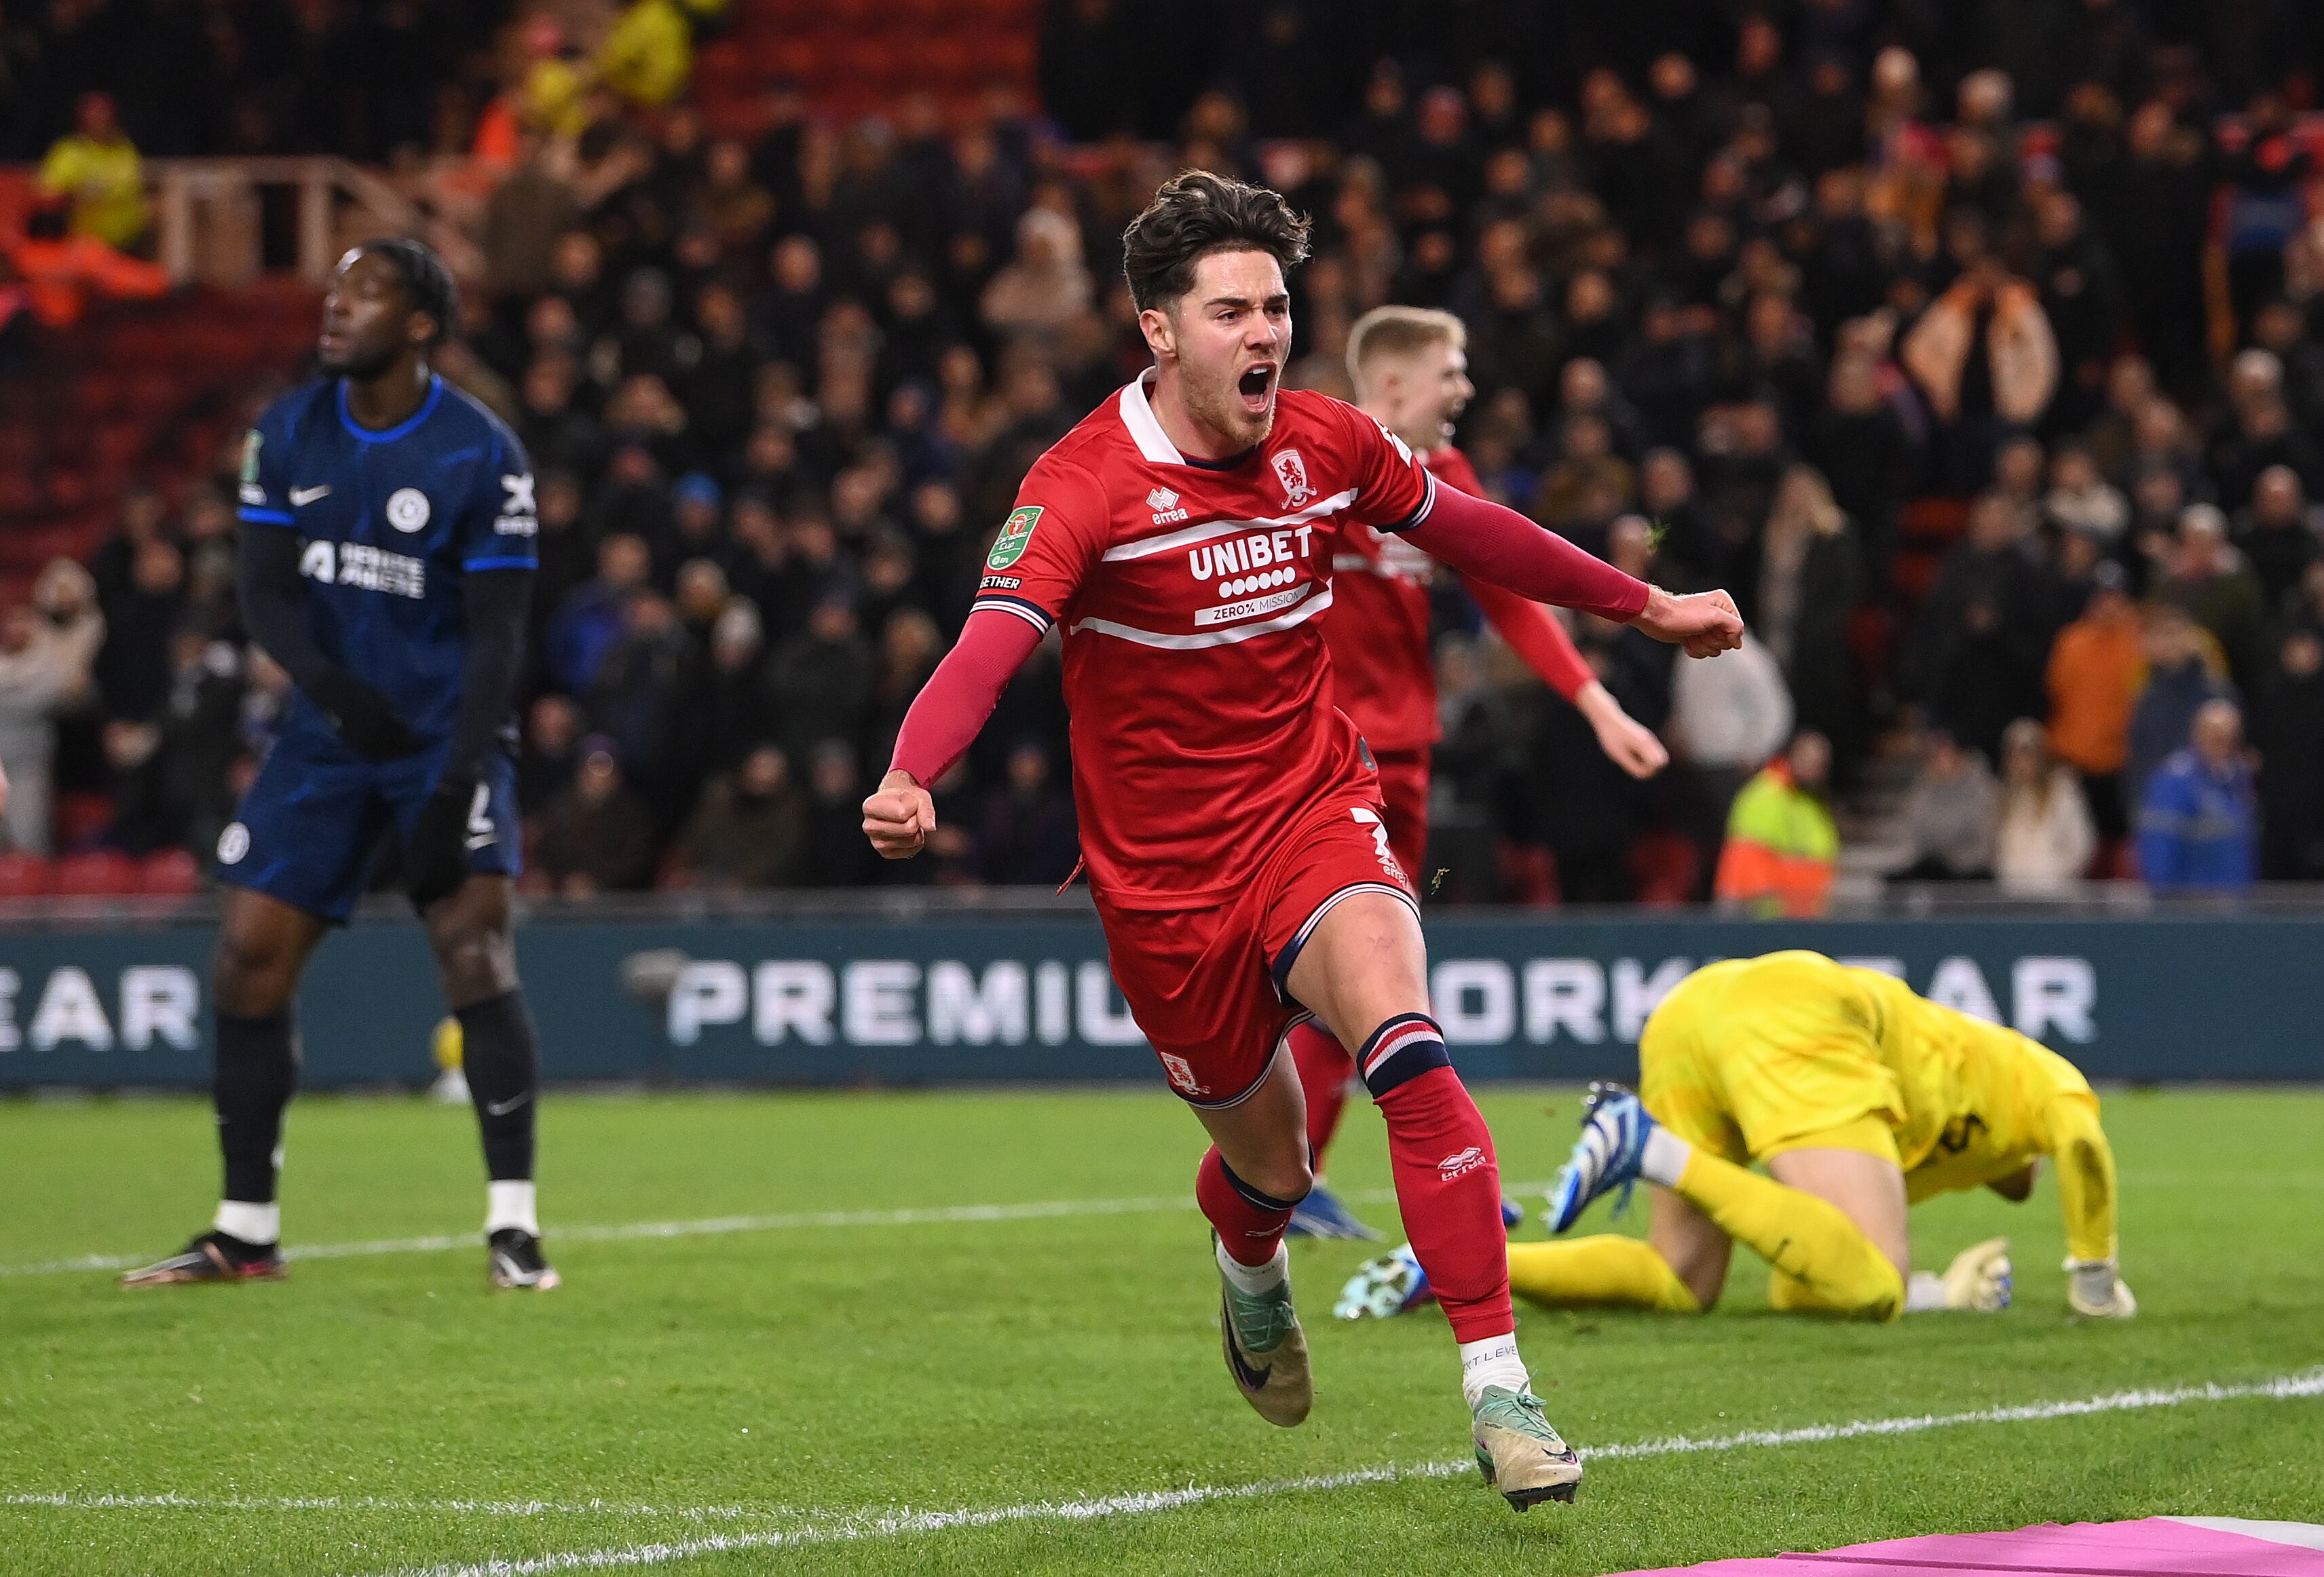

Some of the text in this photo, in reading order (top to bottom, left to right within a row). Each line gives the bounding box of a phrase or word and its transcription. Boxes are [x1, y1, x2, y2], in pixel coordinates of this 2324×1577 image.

[1189, 525, 1313, 581] UNIBET
[1213, 591, 1300, 620] ZERO% MISSION
[0, 965, 200, 1052] AR
[666, 957, 1149, 1047] PREMIU
[1484, 1345, 1518, 1362] LEVE
